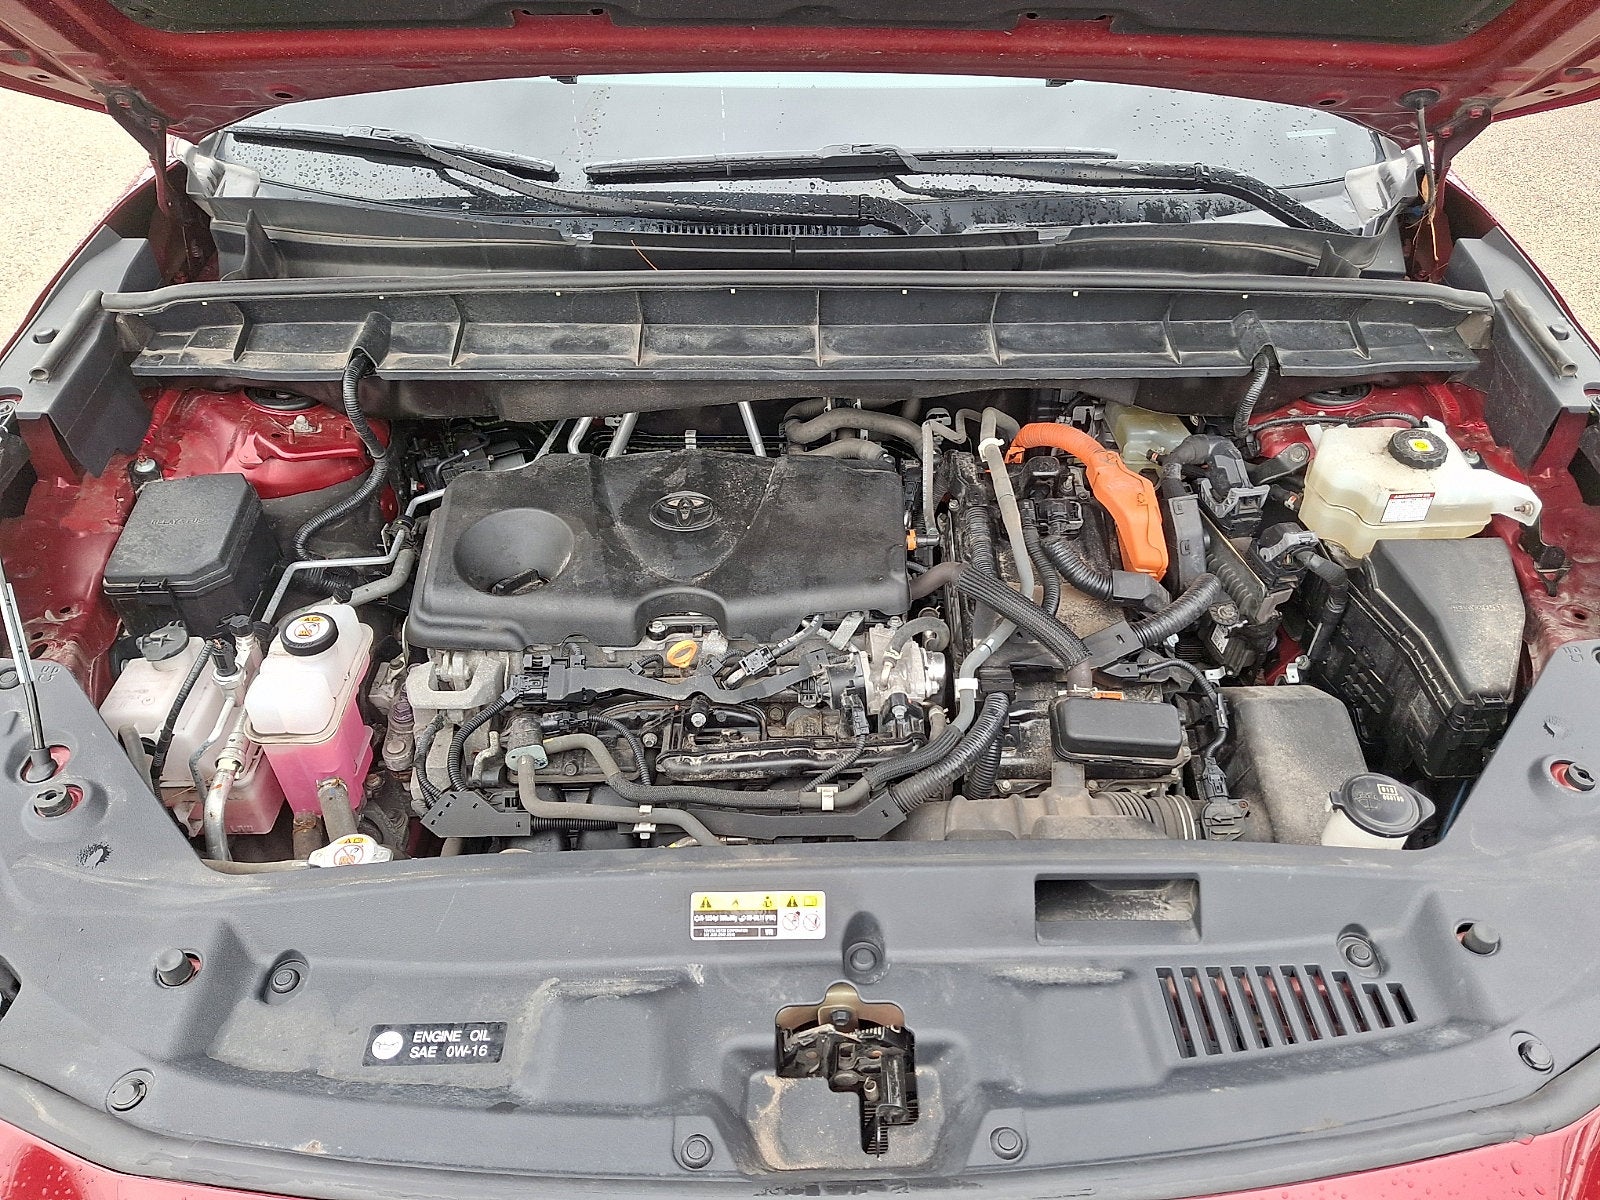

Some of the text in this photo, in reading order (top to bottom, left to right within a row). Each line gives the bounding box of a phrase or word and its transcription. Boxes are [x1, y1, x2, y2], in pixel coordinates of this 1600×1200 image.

[412, 1029, 491, 1043] ENGINE OIL
[409, 1045, 488, 1059] SAE 0W-16
